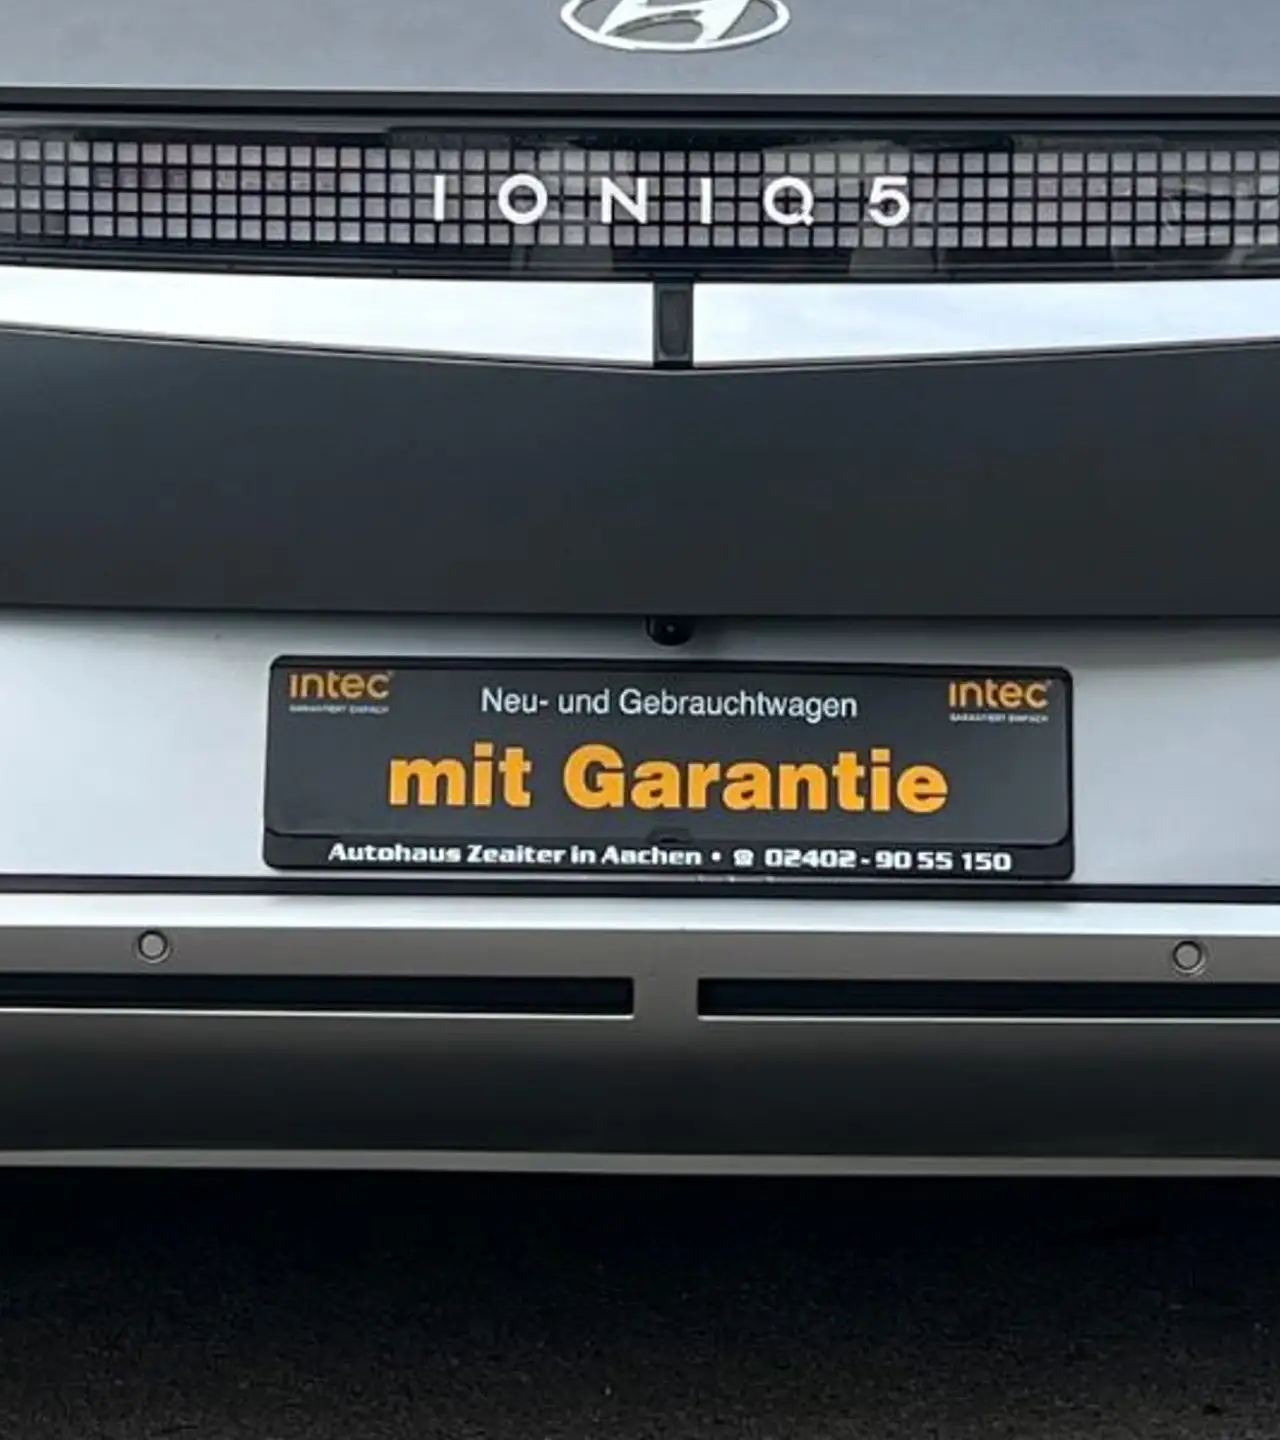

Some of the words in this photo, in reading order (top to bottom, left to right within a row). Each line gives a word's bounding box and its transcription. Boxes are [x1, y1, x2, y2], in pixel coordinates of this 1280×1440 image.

[433, 173, 814, 226] IONIQ
[867, 175, 911, 227] 5
[289, 670, 390, 700] intec
[948, 678, 1049, 709] intec
[480, 686, 549, 714] Neu-
[557, 687, 610, 714] und
[618, 687, 858, 725] Gebrauchtwagen
[389, 742, 531, 808] mit
[563, 743, 948, 813] Garantie
[327, 841, 462, 864] Autohaus
[570, 845, 597, 865] in
[600, 845, 703, 867] Aachen
[917, 851, 955, 871] 55
[960, 852, 1013, 872] 150
